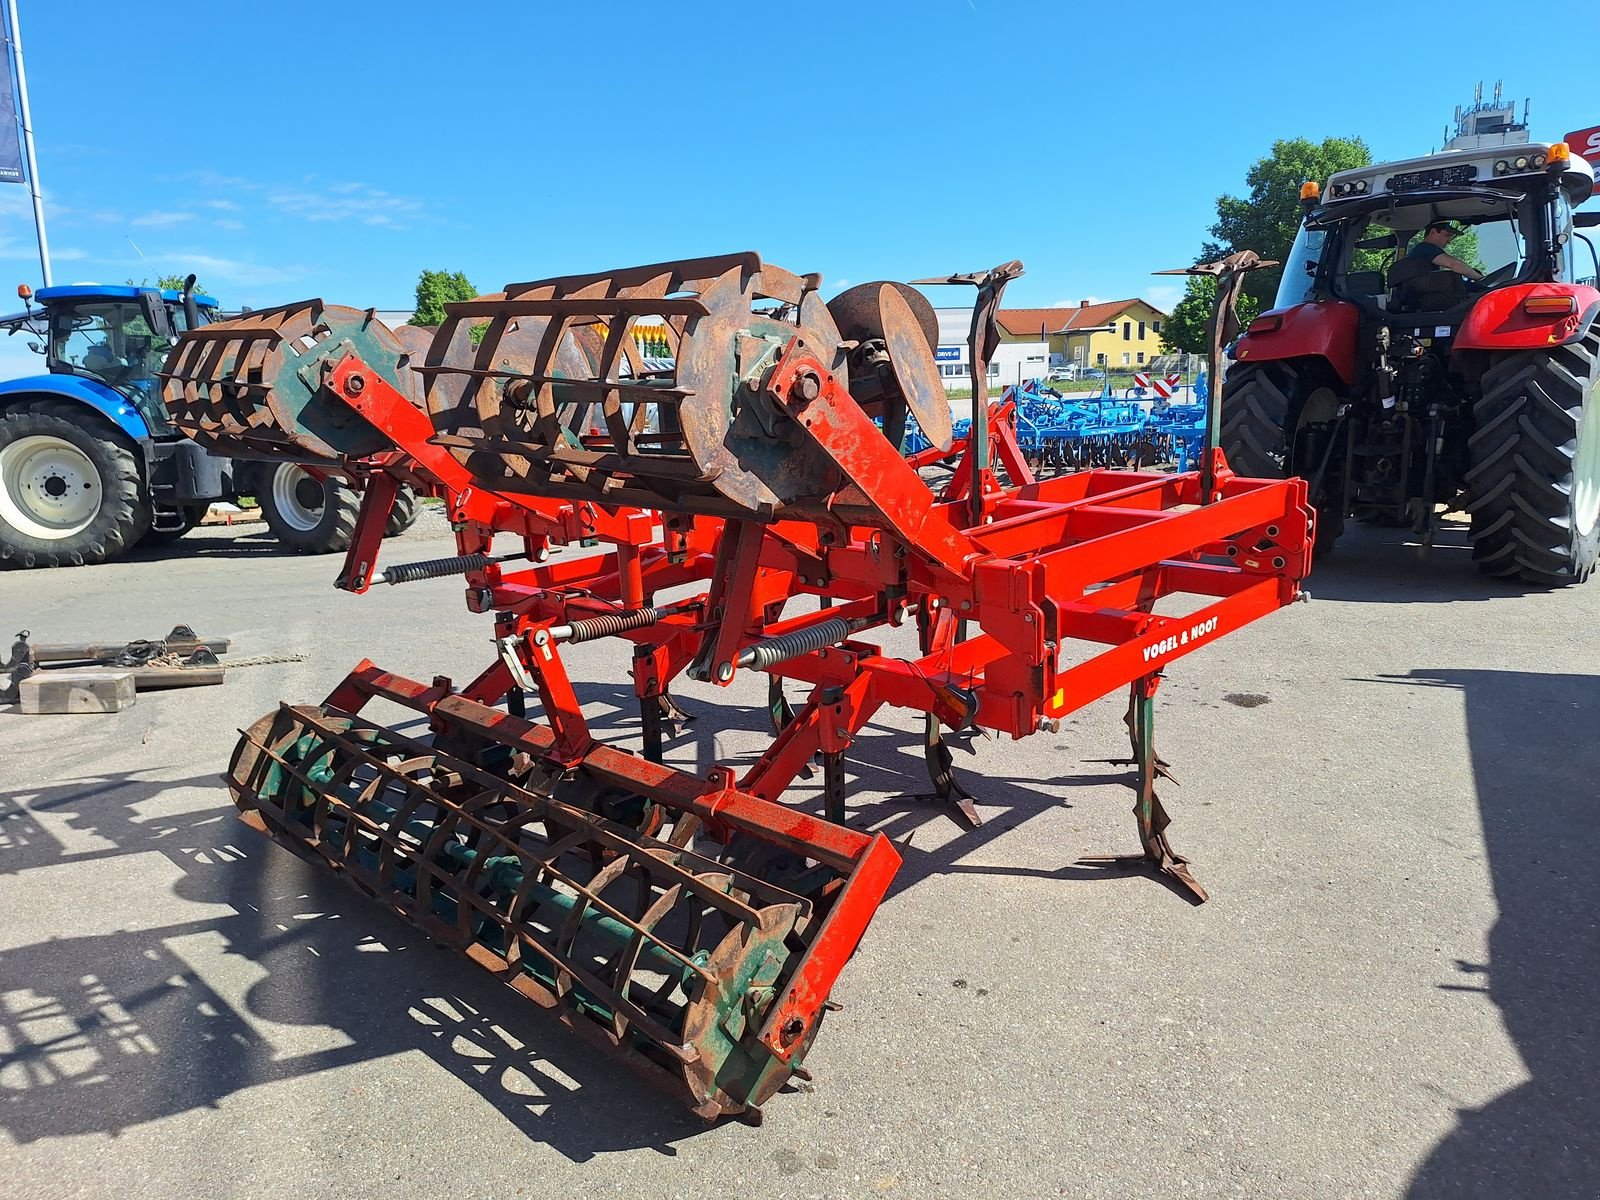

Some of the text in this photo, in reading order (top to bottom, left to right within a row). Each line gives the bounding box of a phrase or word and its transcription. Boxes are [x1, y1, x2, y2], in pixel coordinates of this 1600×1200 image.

[1142, 616, 1218, 662] VOGEL & NOOT
